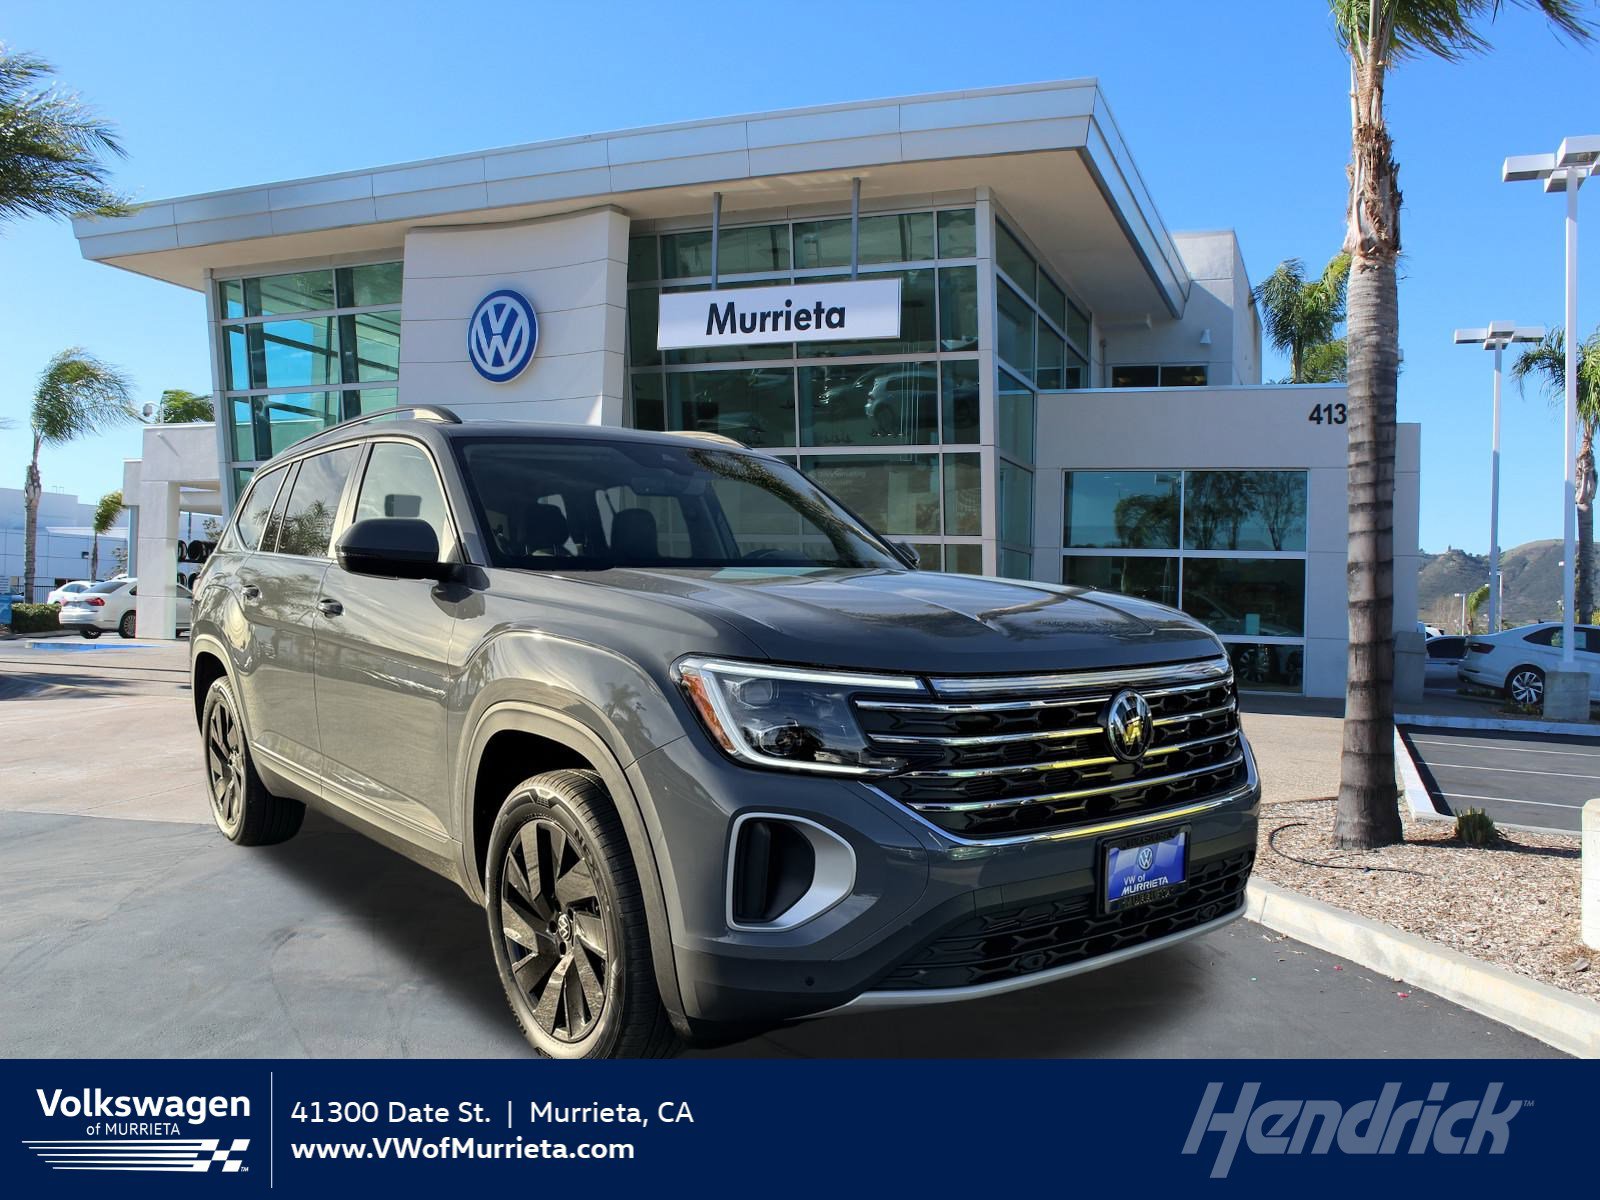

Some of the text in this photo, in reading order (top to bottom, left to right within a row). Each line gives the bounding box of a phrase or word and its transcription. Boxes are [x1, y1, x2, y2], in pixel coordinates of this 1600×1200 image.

[706, 299, 846, 335] Murrieta
[470, 294, 532, 376] VW
[1121, 876, 1169, 897] MURRIETA
[1123, 873, 1146, 886] VW of
